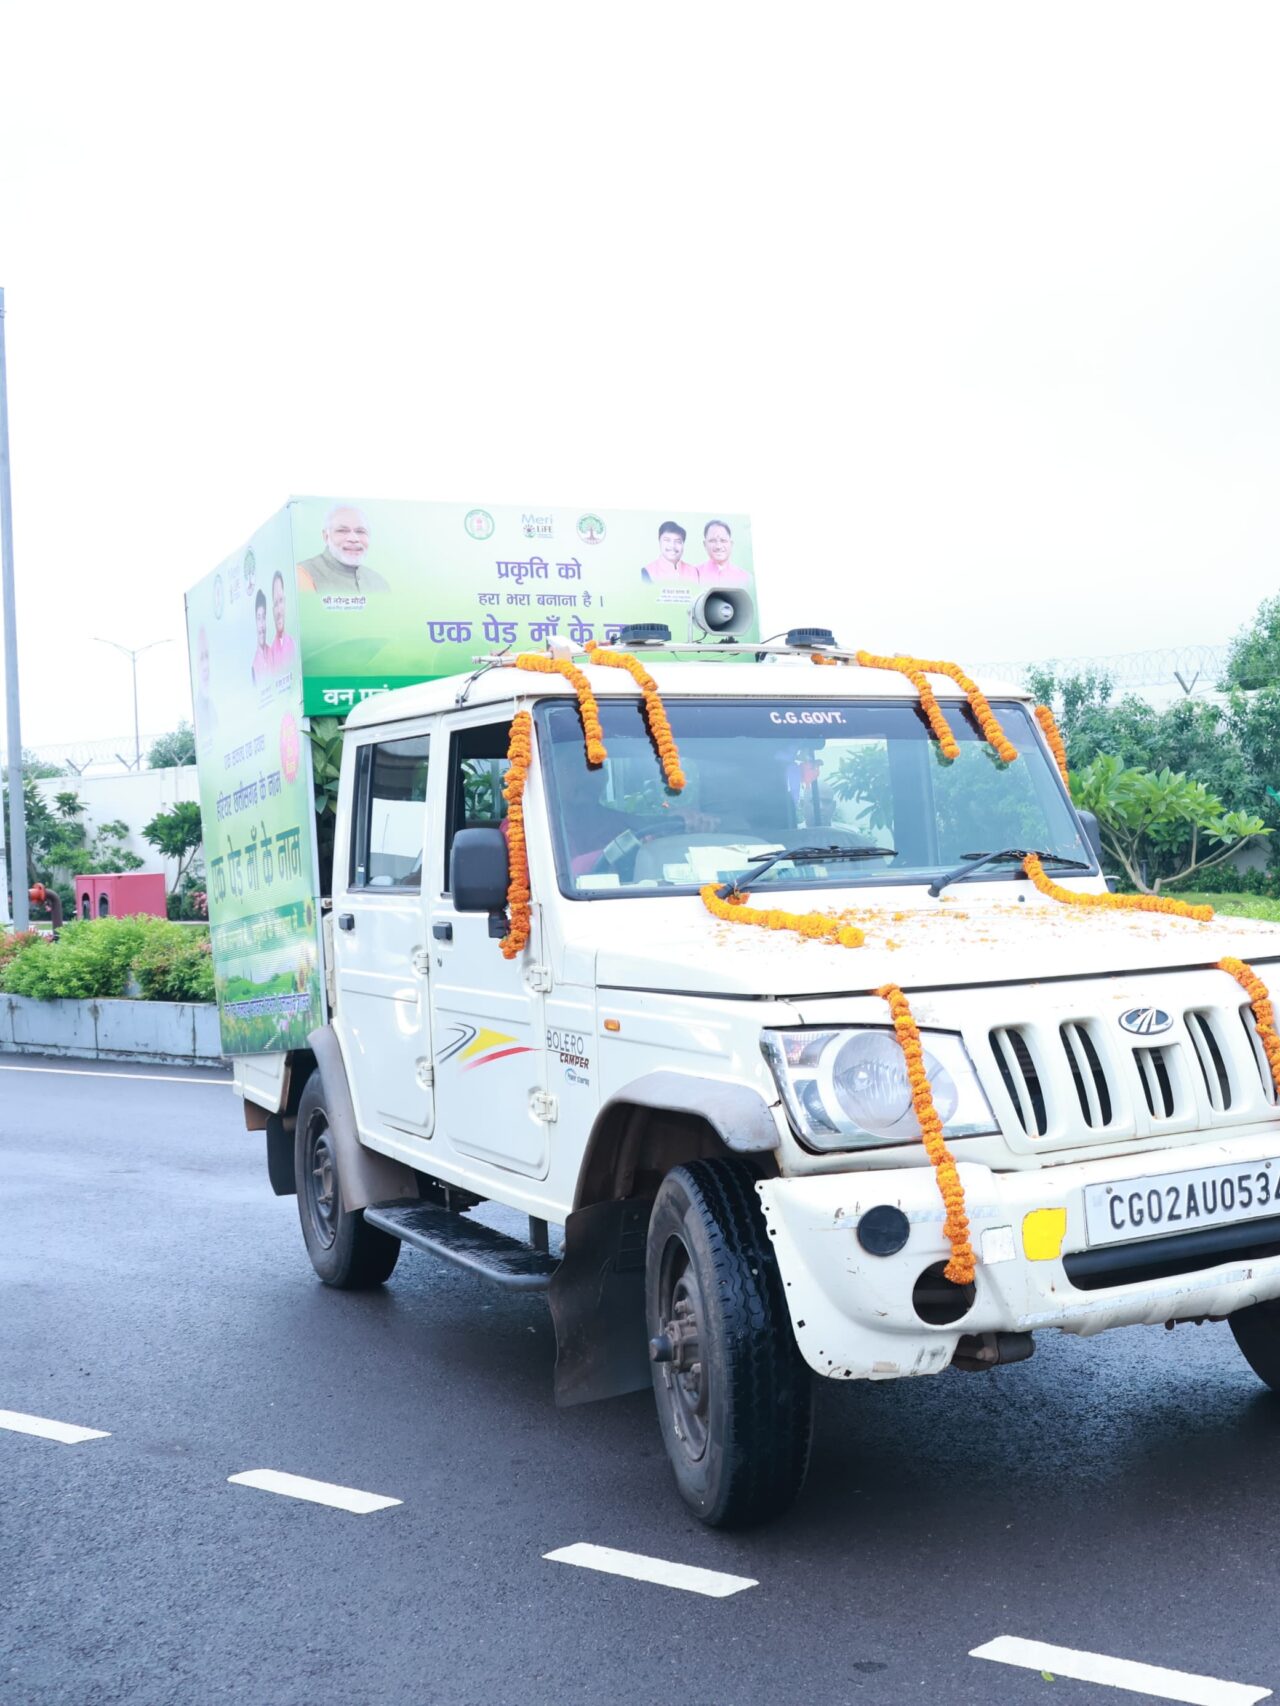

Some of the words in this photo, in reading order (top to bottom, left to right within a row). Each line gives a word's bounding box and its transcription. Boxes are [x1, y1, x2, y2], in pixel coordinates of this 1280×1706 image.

[521, 514, 553, 524] Meri
[496, 556, 549, 585] प्रकृति
[556, 557, 582, 580] को
[478, 592, 500, 606] हरा
[506, 593, 530, 606] भरा
[536, 594, 577, 607] बनाना
[582, 590, 592, 608] है
[427, 621, 472, 644] एक
[567, 615, 594, 644] के
[322, 688, 355, 706] वन
[769, 711, 847, 724] C.G.GOVT.
[211, 855, 226, 904] एक
[227, 834, 243, 904] पेड़
[245, 825, 260, 890] माँ
[260, 820, 273, 886] के
[276, 826, 302, 880] नाम
[547, 1029, 584, 1055] BOLERO
[560, 1052, 589, 1069] CAMPER
